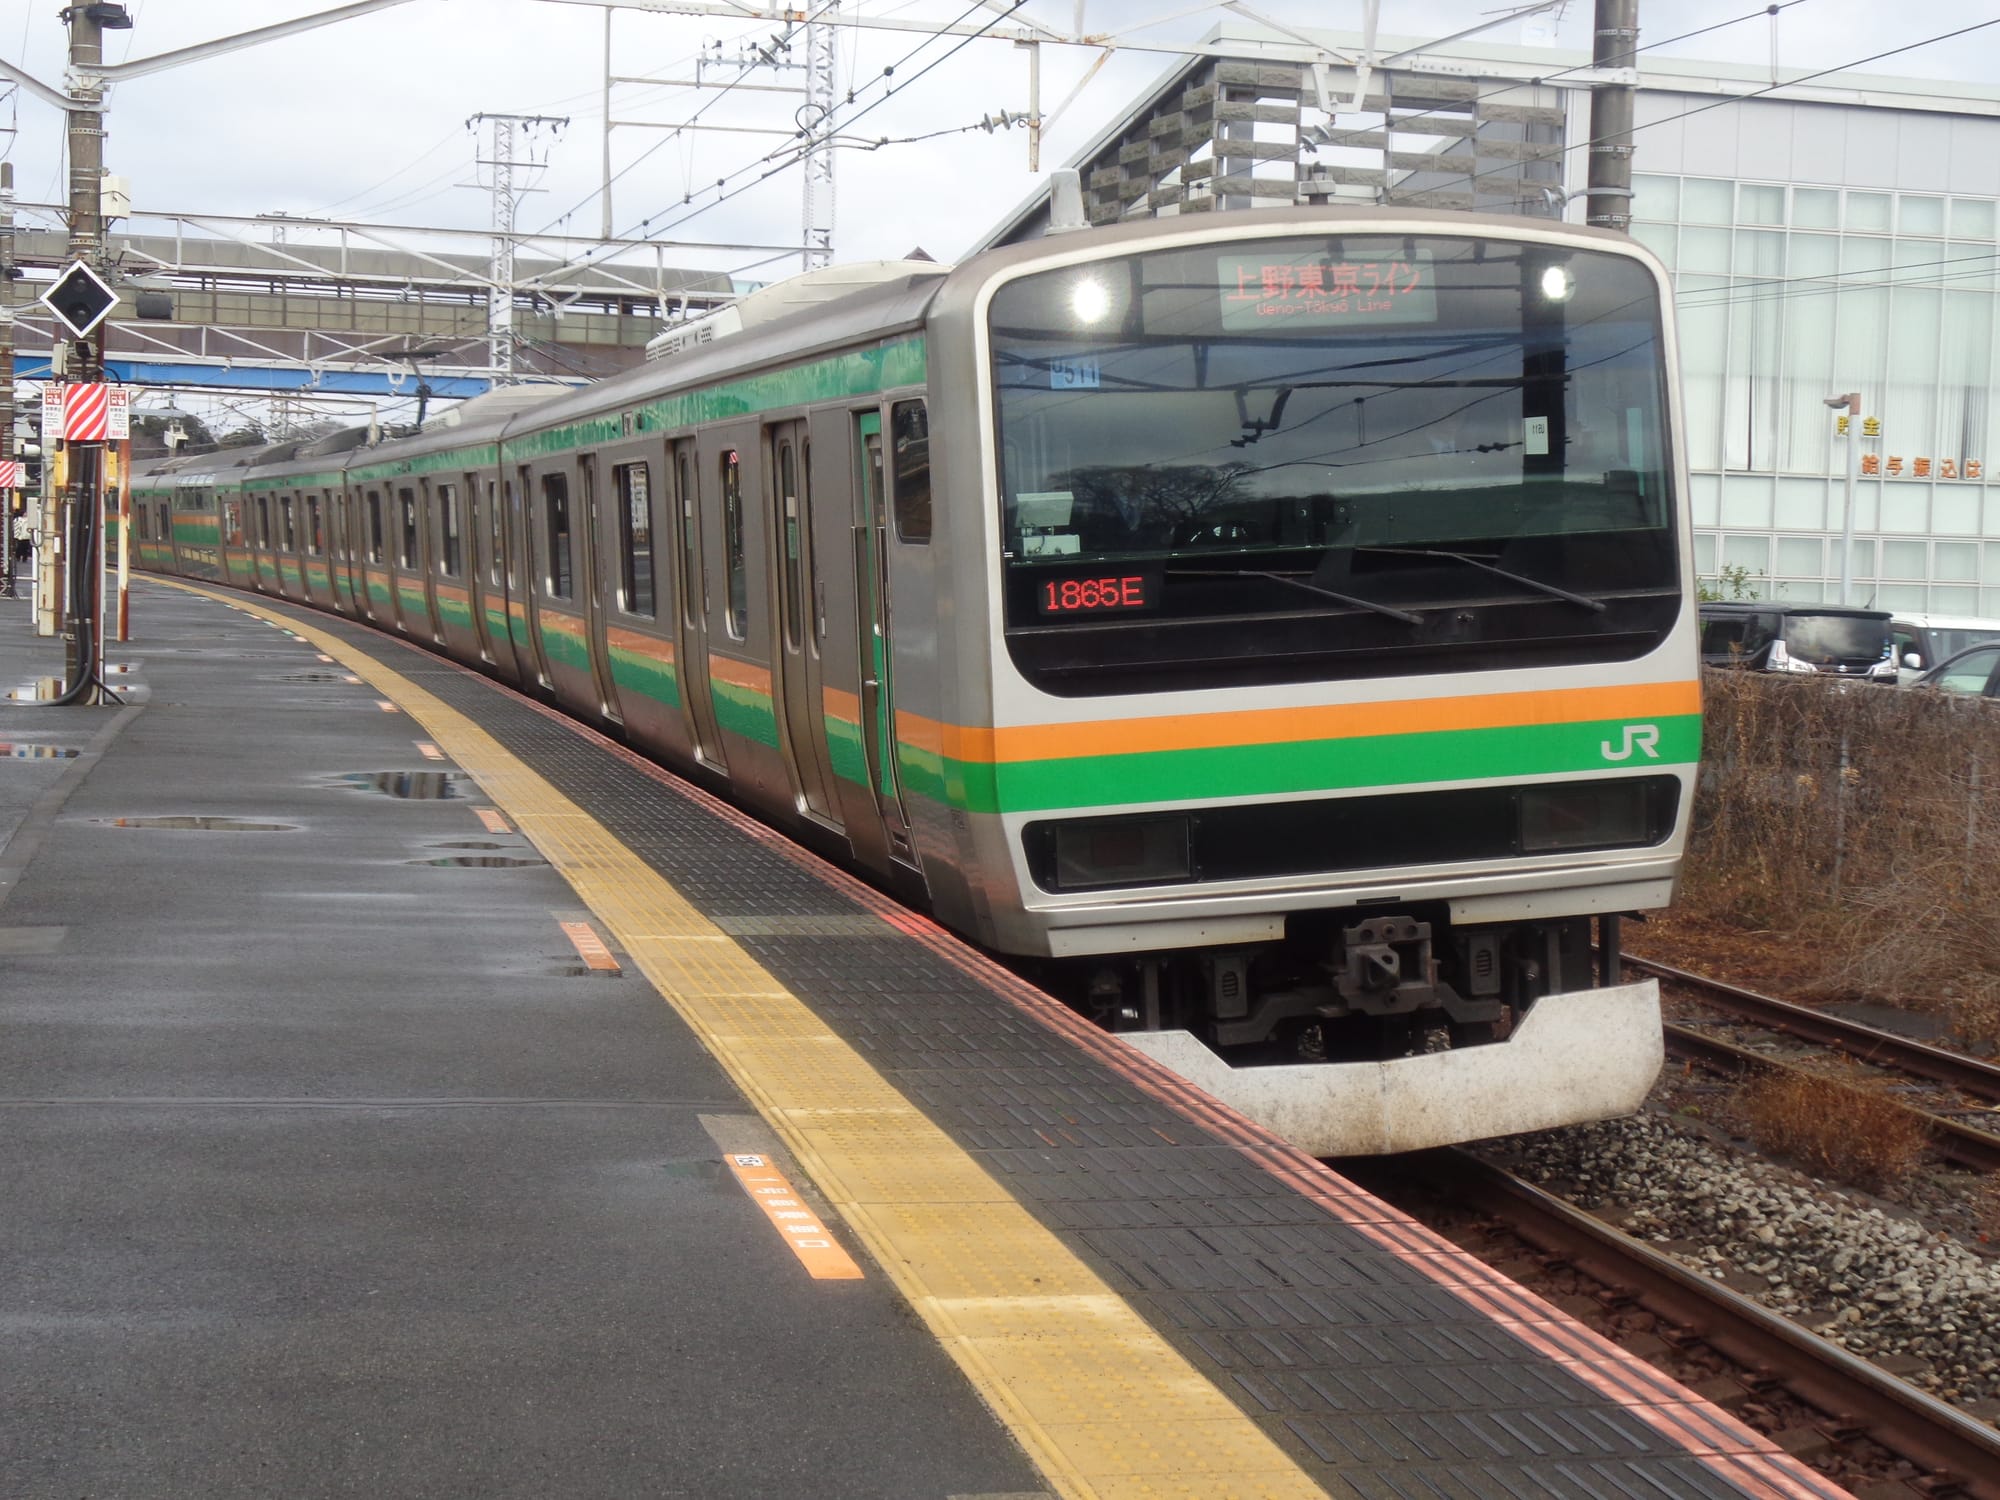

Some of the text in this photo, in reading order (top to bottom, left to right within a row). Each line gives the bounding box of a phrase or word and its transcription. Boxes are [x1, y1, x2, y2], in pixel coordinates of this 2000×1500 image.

[1227, 262, 1420, 300] 上野東京ライン
[1357, 298, 1393, 311] Line
[1861, 453, 1982, 480] 給与振込は
[1046, 576, 1144, 610] 1865E
[1601, 724, 1660, 761] JR
